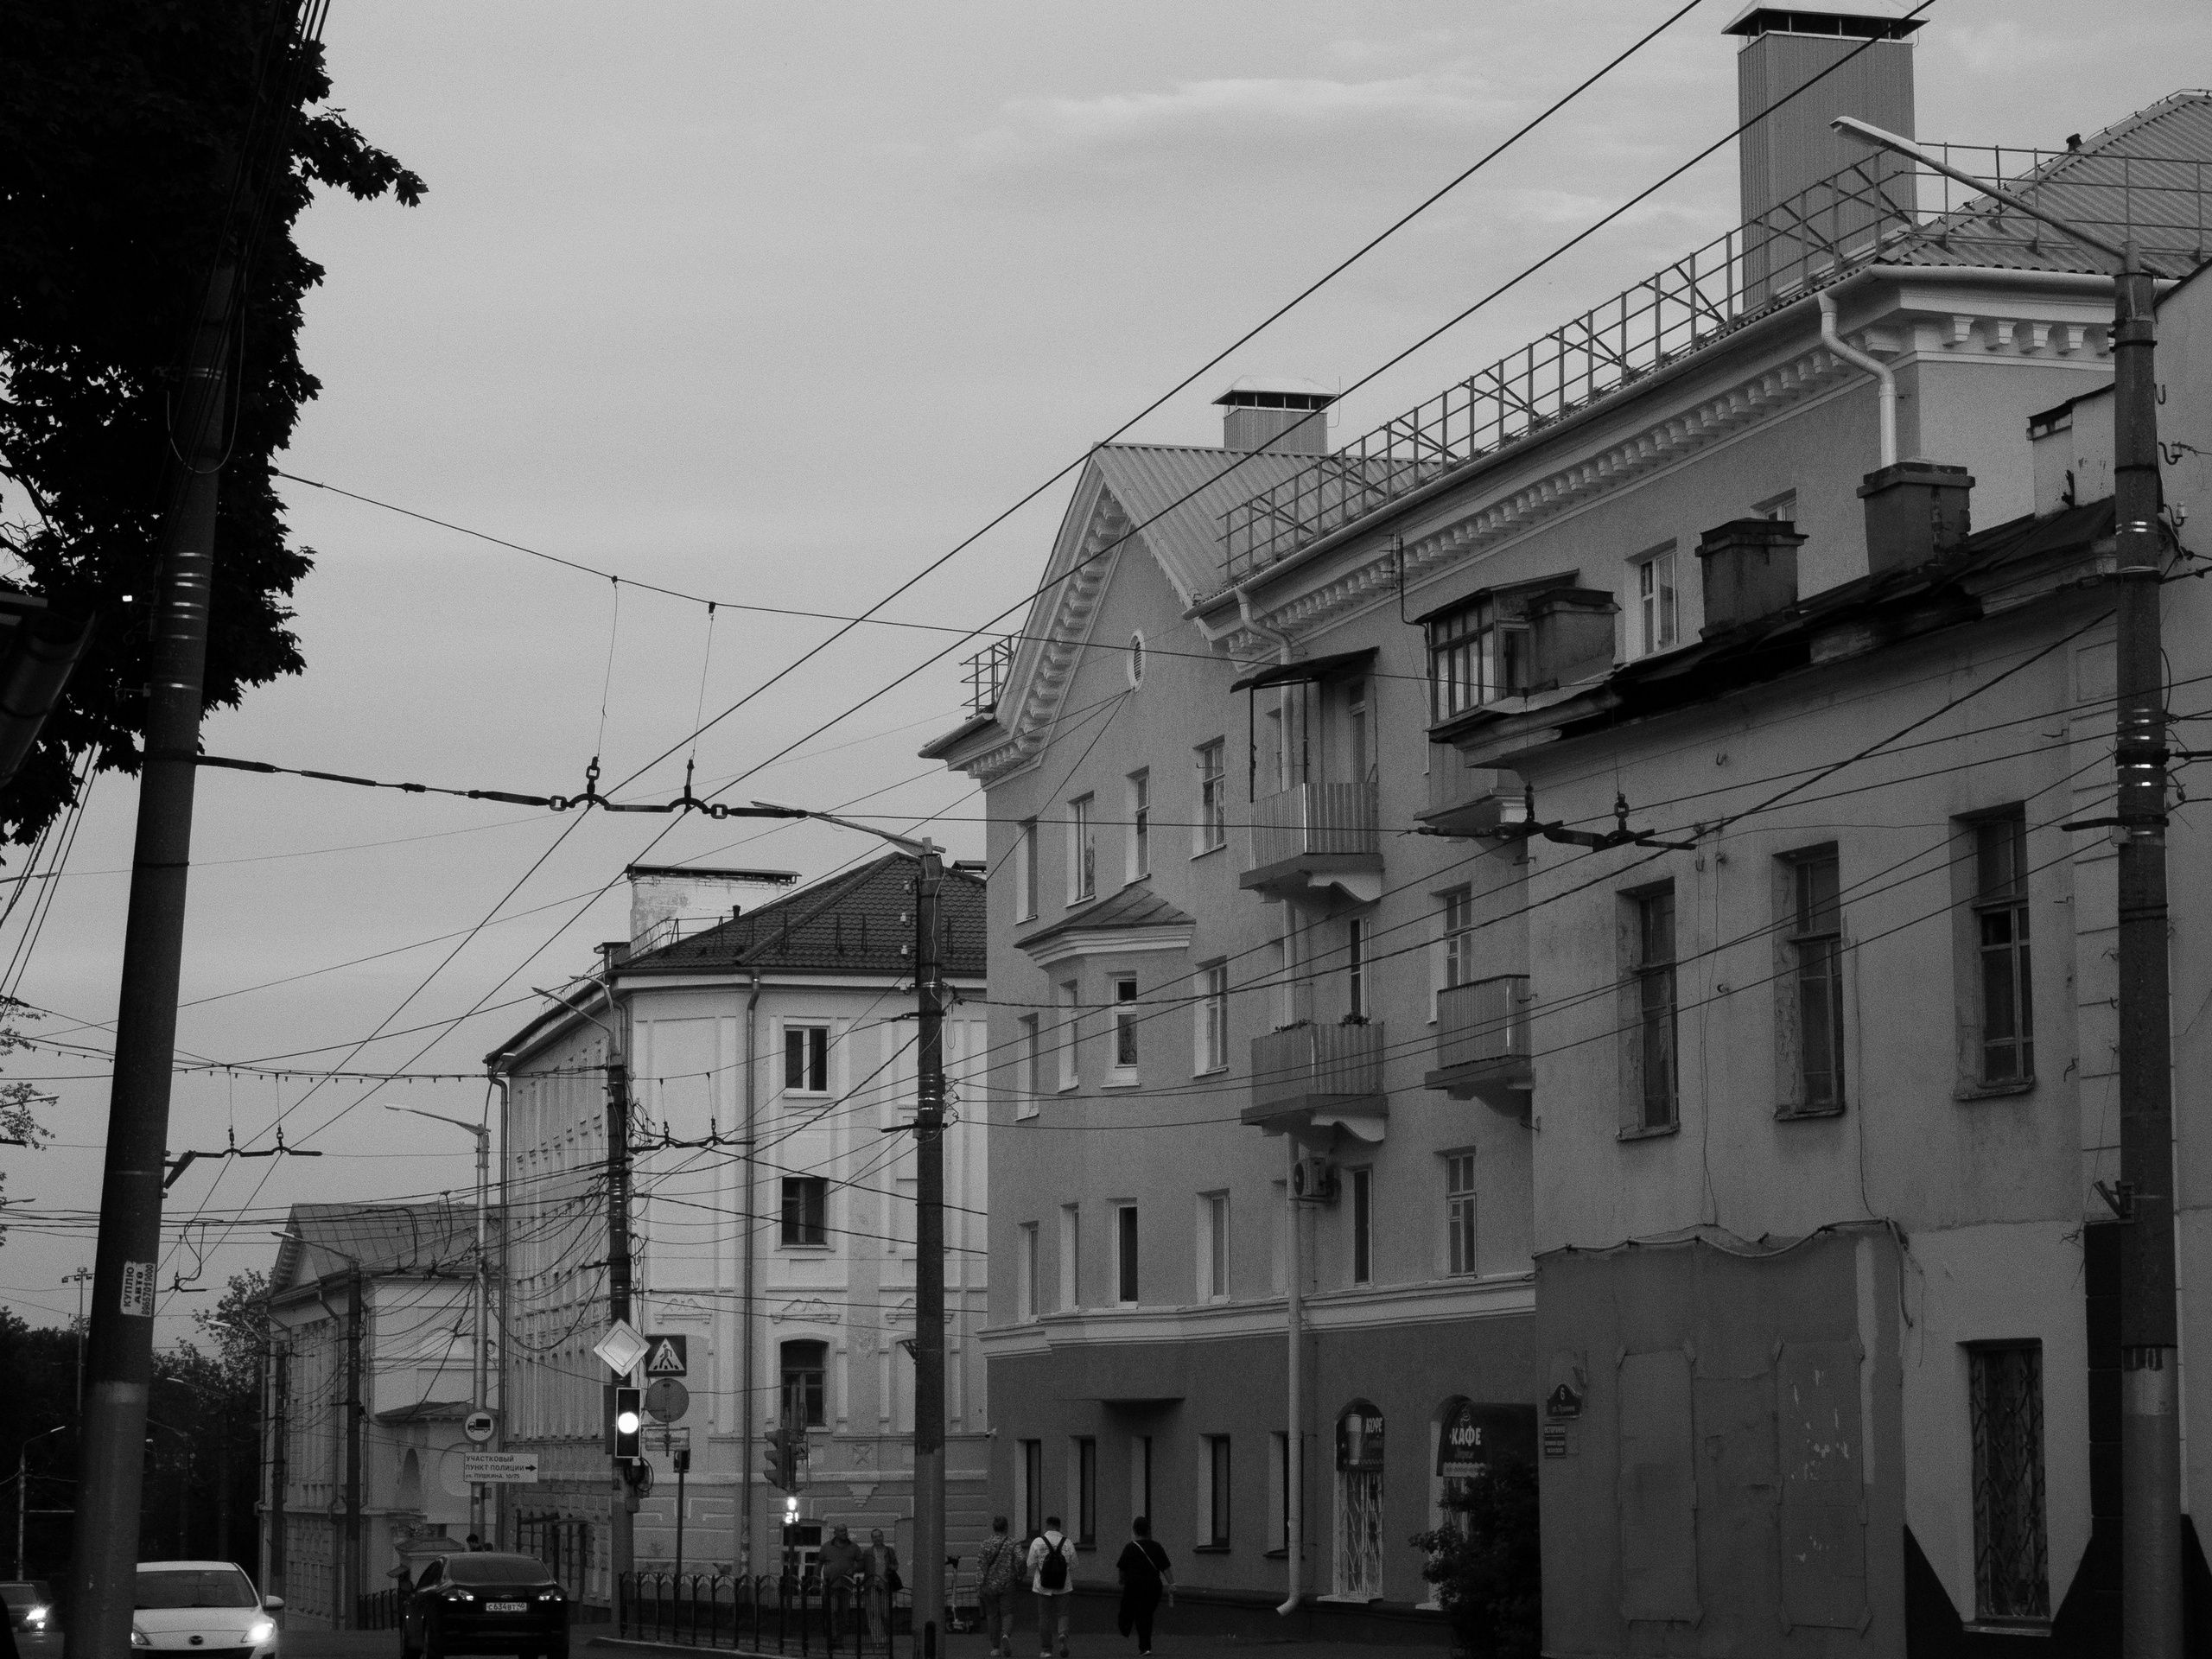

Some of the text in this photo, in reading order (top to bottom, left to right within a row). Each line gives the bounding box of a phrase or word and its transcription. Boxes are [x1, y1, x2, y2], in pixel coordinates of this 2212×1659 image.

[124, 1266, 135, 1307] КУПЛЮ
[134, 1271, 143, 1304] АВТО
[1560, 1387, 1566, 1401] 6
[1365, 1417, 1383, 1433] КОФЕ
[1451, 1425, 1482, 1447] КАФЕ
[785, 1512, 799, 1524] 21
